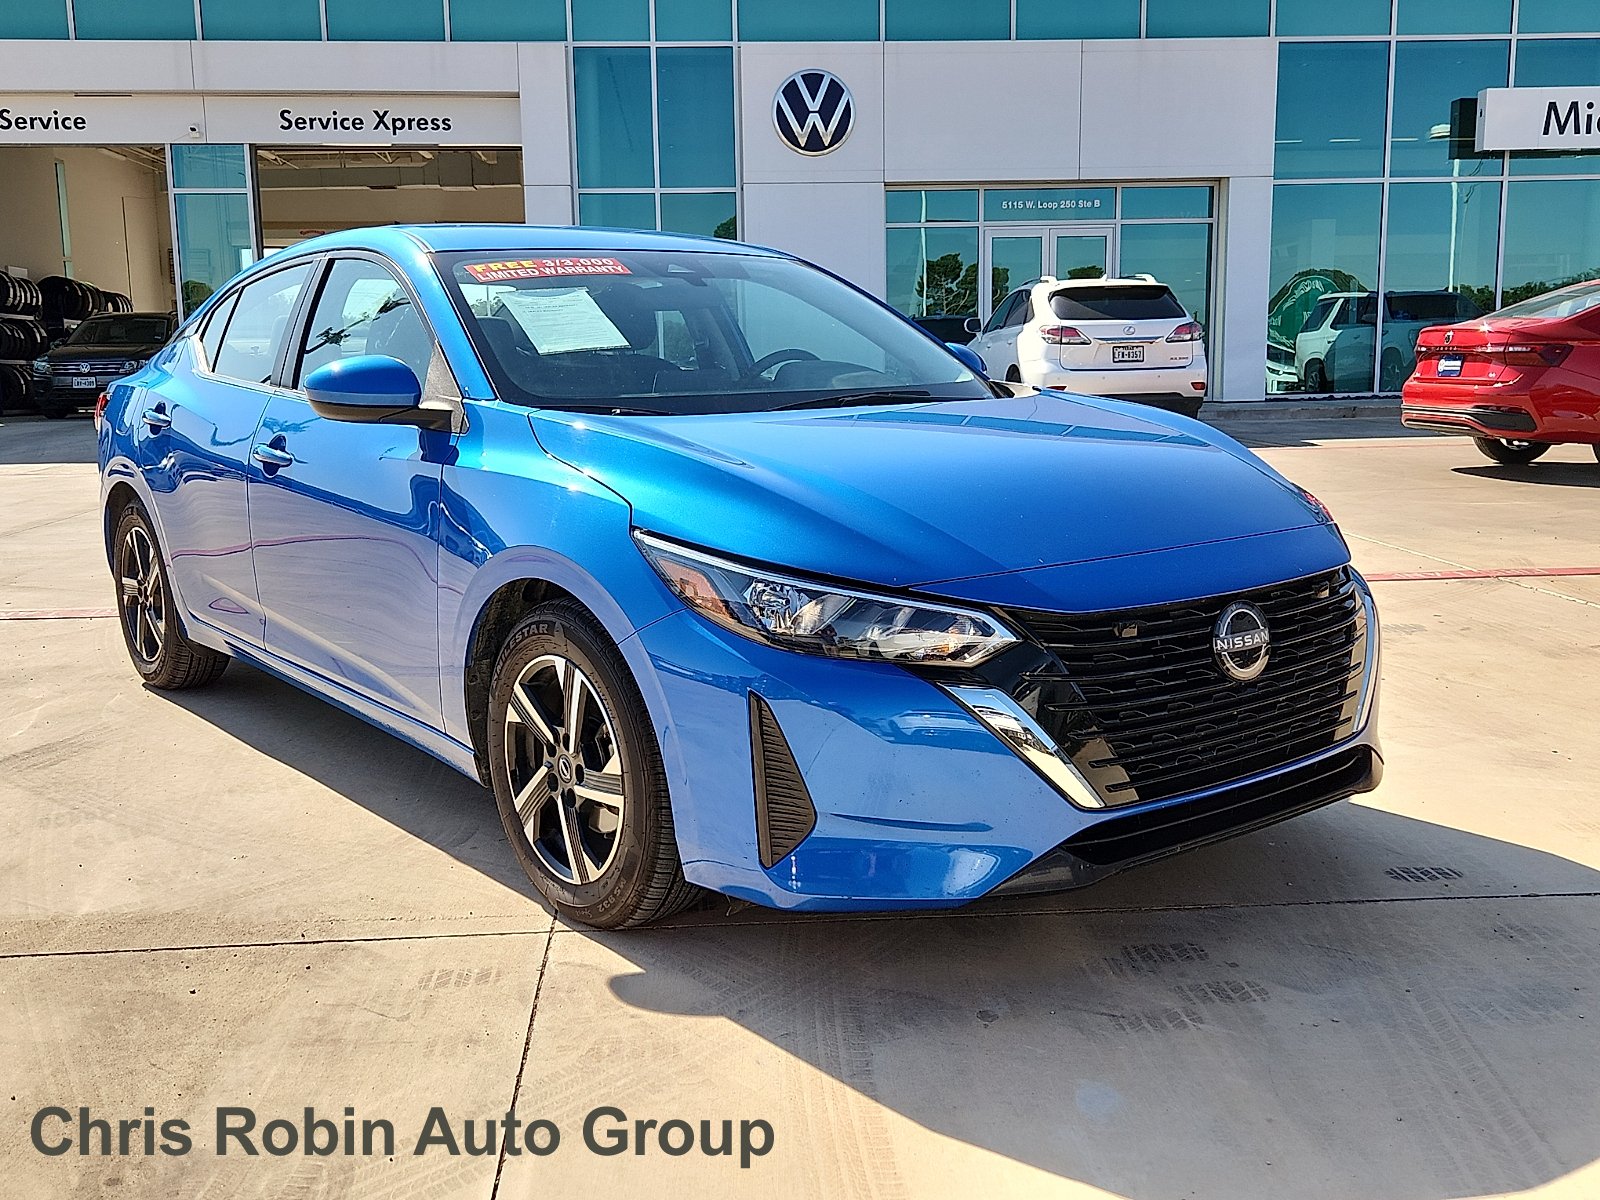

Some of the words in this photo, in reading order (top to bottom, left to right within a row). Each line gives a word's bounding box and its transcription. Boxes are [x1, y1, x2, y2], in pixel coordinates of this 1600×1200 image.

[0, 109, 87, 130] Service
[279, 109, 365, 131] Service
[372, 110, 452, 136] Xpress
[1002, 201, 1023, 209] 5115
[1025, 201, 1036, 209] W.
[1037, 201, 1058, 210] Loop
[1060, 200, 1076, 208] 250
[1078, 200, 1092, 208] Ste
[1094, 199, 1101, 208] B
[474, 260, 537, 272] FREE
[541, 258, 614, 267] 3/3,000
[476, 268, 540, 281] LIMITED
[541, 265, 624, 276] WARRANTY
[496, 623, 549, 675] MILESTAR
[1216, 631, 1268, 650] NISSAN
